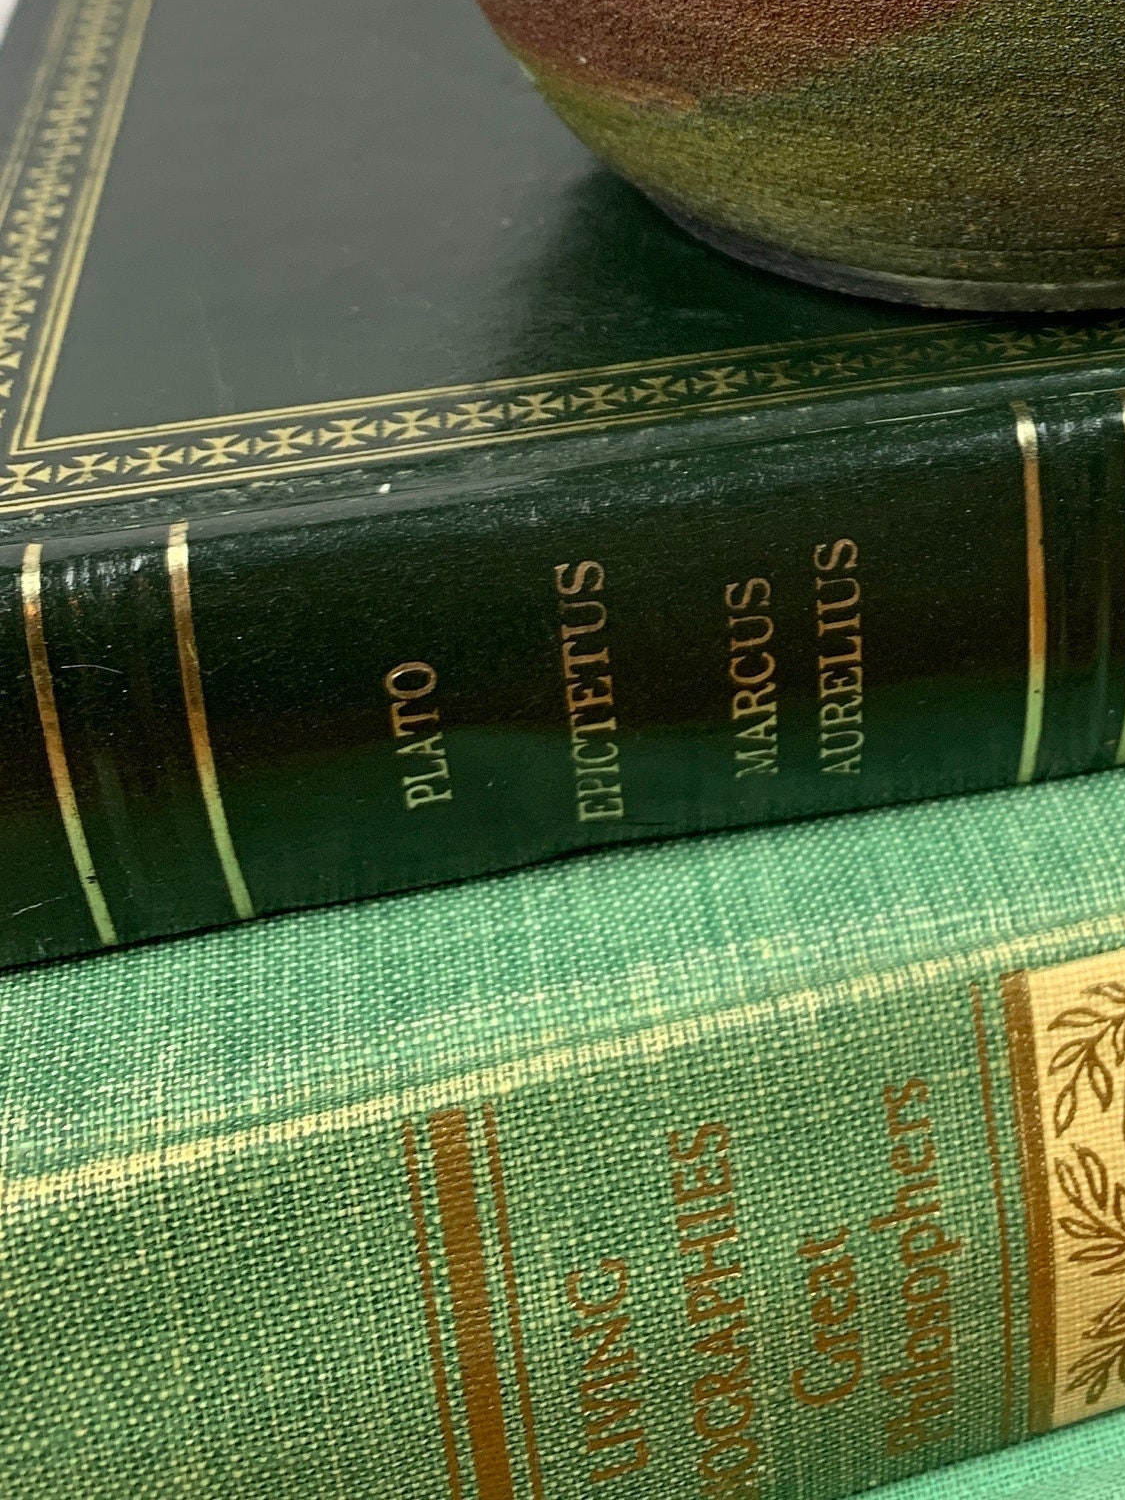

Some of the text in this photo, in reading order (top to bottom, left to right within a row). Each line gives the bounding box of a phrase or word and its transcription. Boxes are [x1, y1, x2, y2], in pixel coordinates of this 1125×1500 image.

[384, 661, 453, 811] PLATO
[554, 560, 625, 823] EPICTETUS
[725, 577, 780, 779] MARCUS
[814, 538, 866, 776] AURELIUS
[566, 1258, 651, 1483] LIVING
[792, 1225, 864, 1407] Great
[869, 1077, 963, 1456] Philosophers
